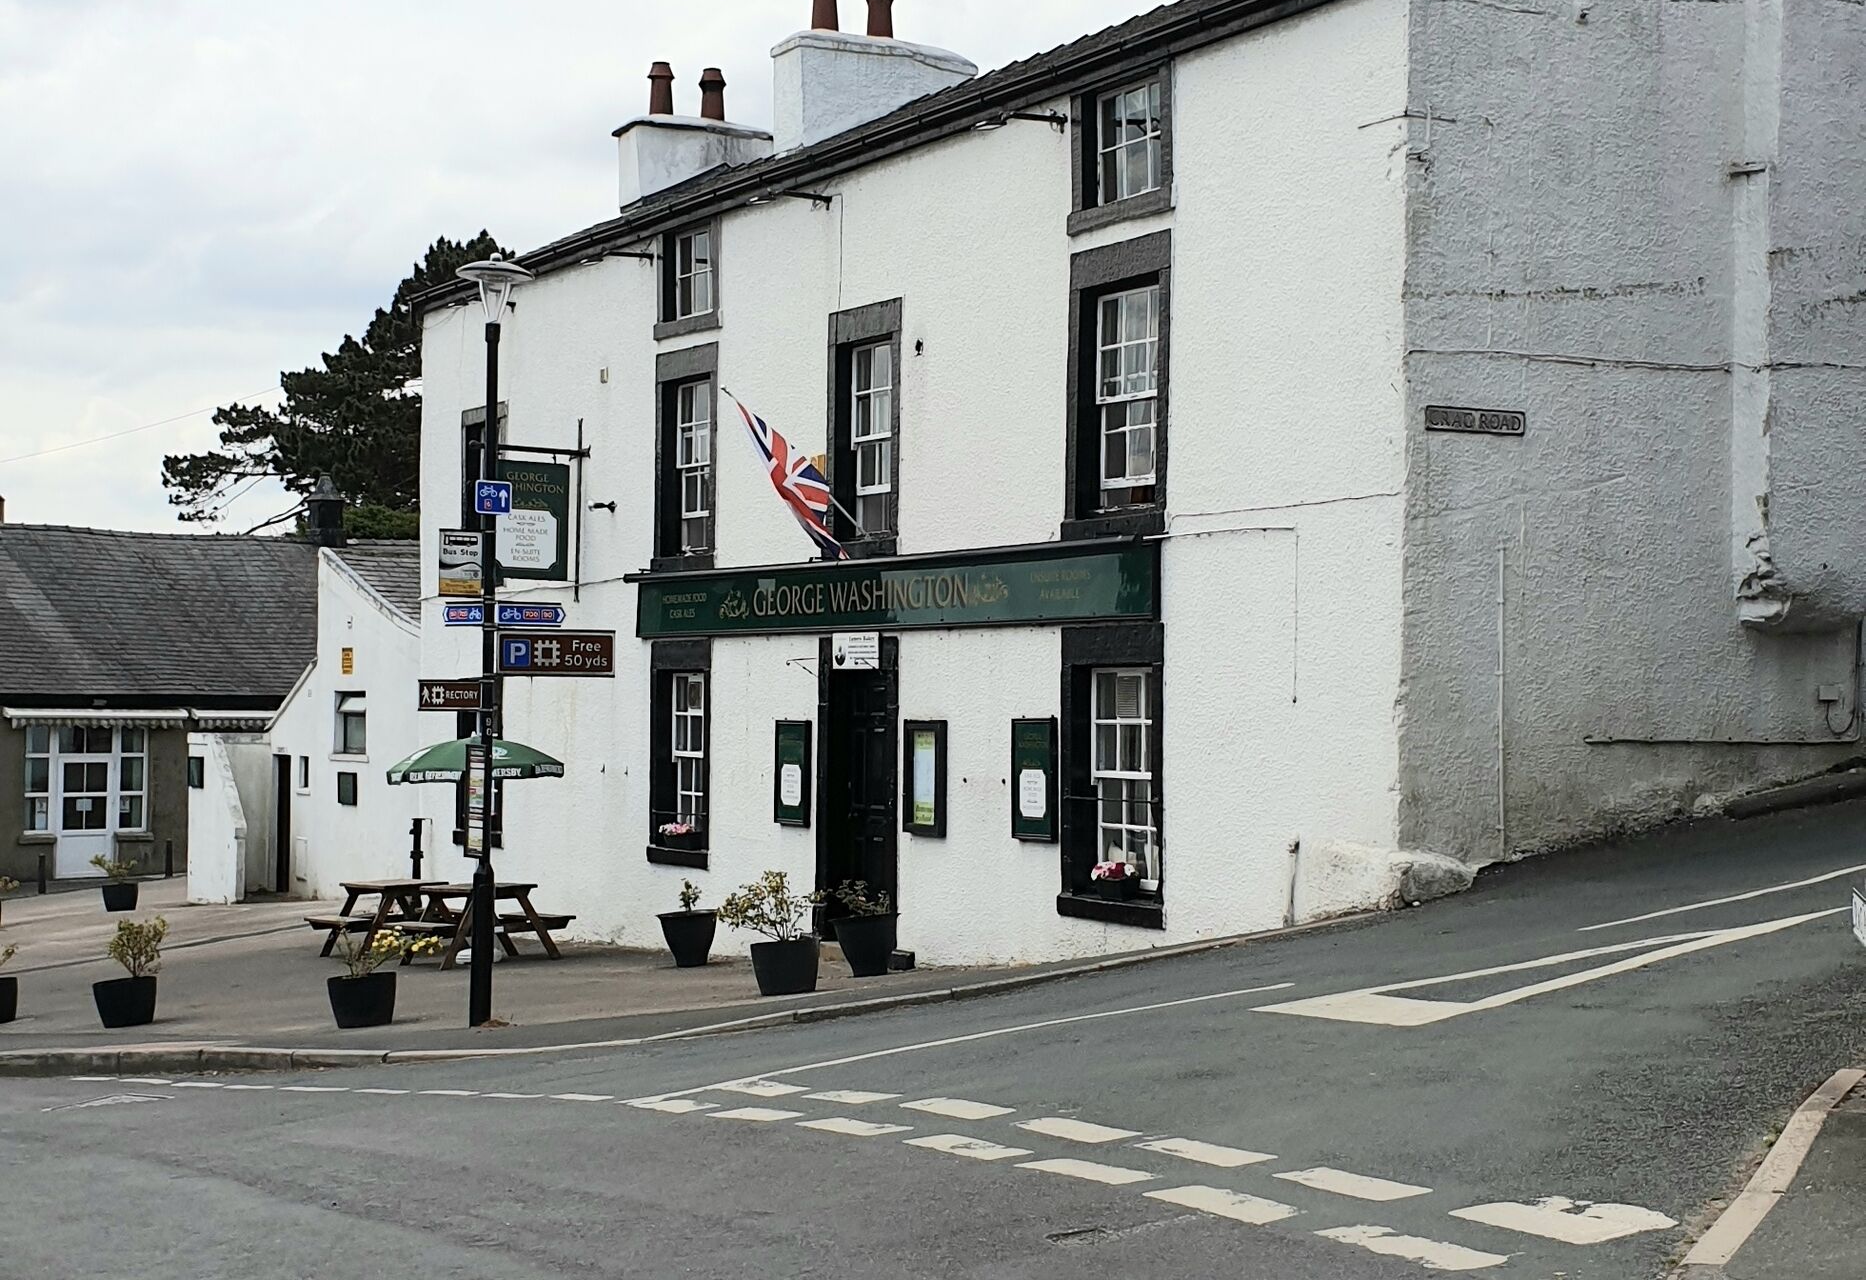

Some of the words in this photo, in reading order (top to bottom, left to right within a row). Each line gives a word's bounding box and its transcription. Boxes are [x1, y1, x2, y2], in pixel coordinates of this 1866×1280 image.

[1479, 412, 1521, 431] ROAD
[506, 471, 549, 482] GEORGE
[512, 482, 564, 494] HINGTON
[528, 515, 546, 523] ALES
[516, 534, 536, 542] FOOD
[460, 548, 479, 557] Stop
[512, 555, 540, 563] ROOMS
[753, 582, 825, 617] GEORGE
[829, 572, 969, 613] WASHINGTON
[572, 640, 601, 652] Free
[510, 642, 527, 664] P
[564, 654, 583, 666] 50
[585, 655, 608, 669] yds
[445, 690, 479, 700] RECTORY
